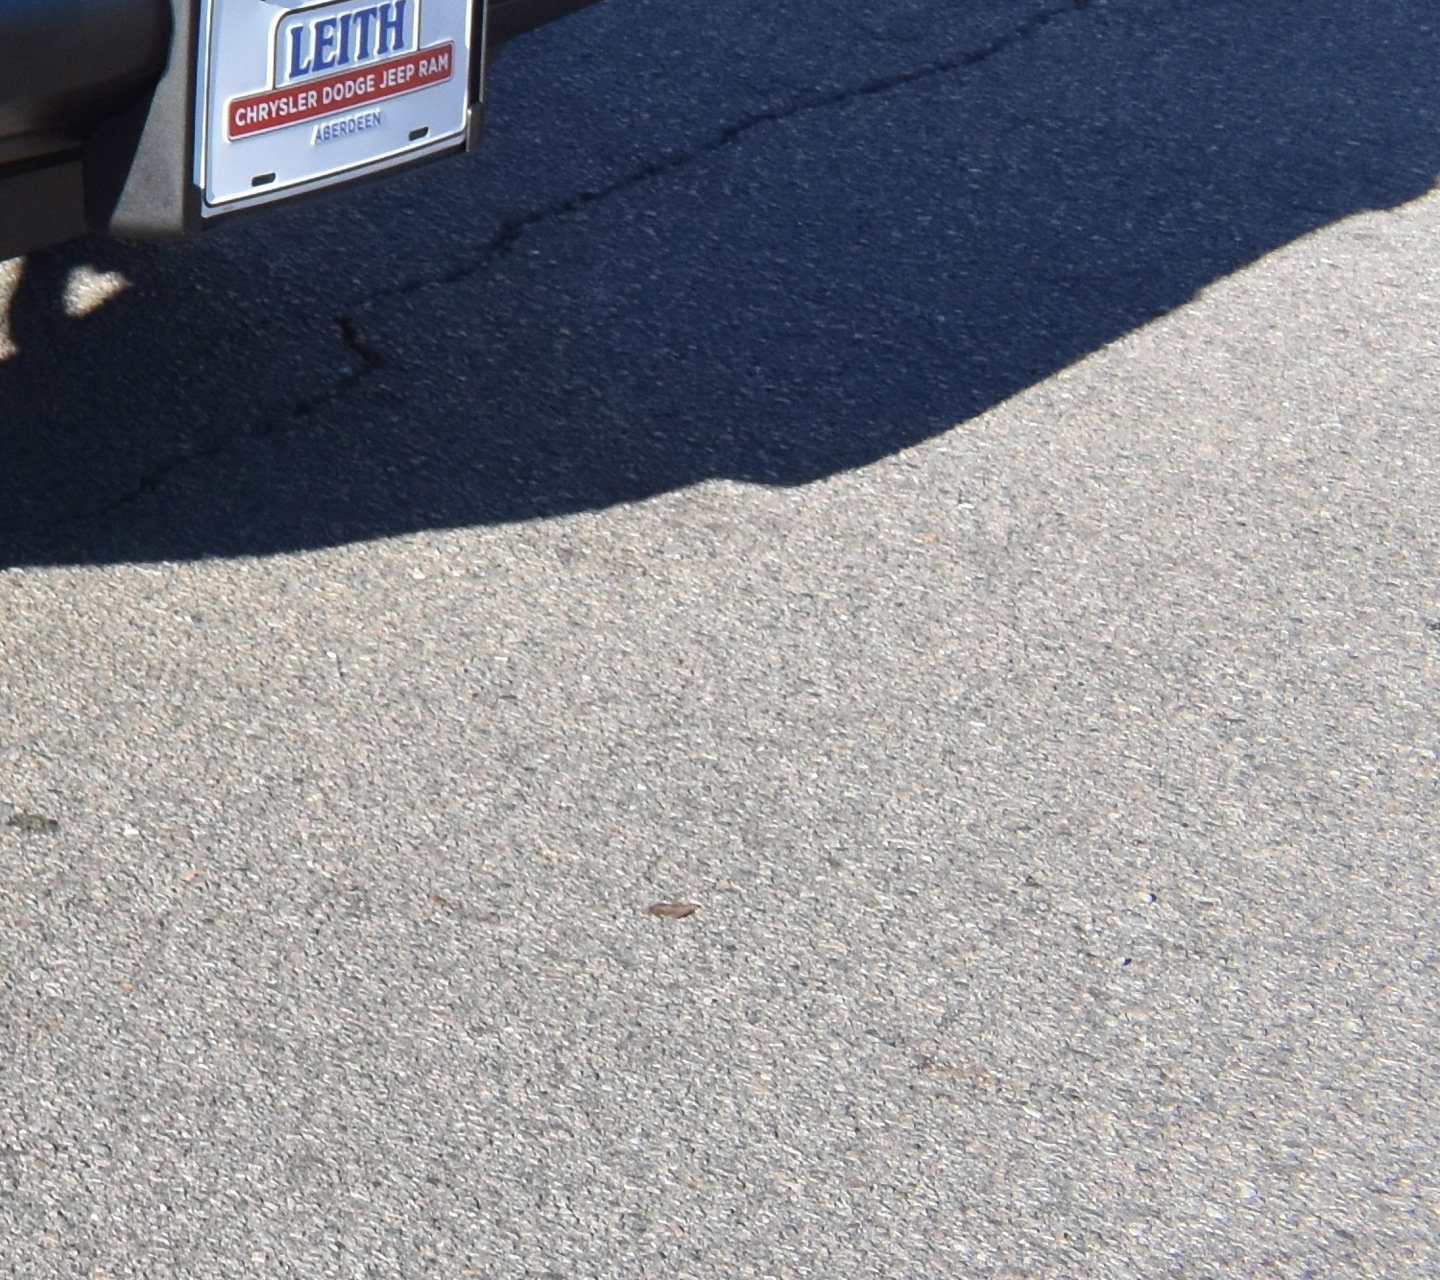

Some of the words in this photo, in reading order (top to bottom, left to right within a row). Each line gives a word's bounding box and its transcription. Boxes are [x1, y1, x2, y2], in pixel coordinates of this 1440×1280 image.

[288, 0, 406, 79] LEITH
[234, 89, 318, 127] CHRYSLER
[322, 73, 376, 104] DODGE
[379, 65, 415, 90] JEEP
[418, 52, 449, 79] RAM
[312, 108, 382, 144] ABERDEEN
